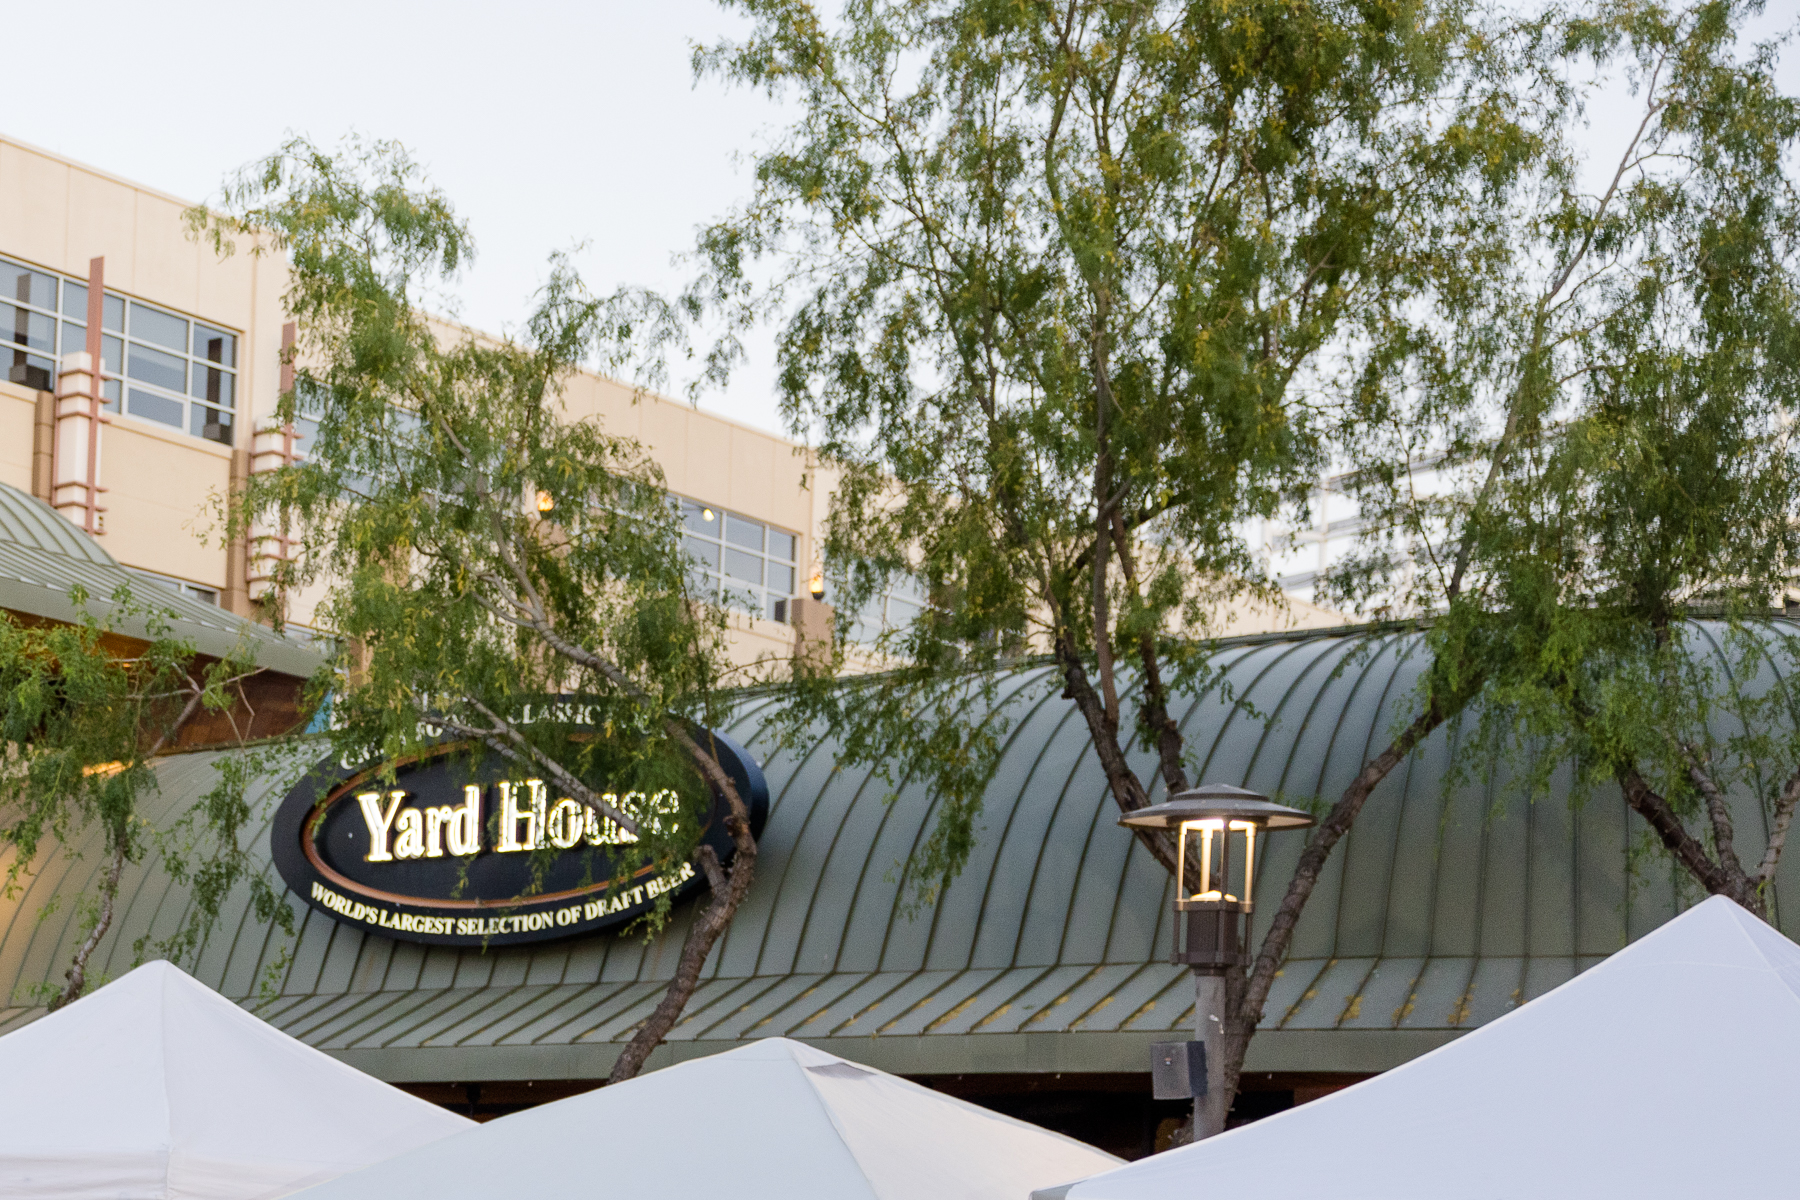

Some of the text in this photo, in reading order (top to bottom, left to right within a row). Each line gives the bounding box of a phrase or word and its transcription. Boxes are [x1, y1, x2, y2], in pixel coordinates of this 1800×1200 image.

[357, 784, 481, 862] Yard
[311, 881, 380, 925] WORLD'S
[378, 908, 456, 935] LARGEST
[456, 911, 555, 936] SELECTION
[555, 905, 583, 927] OF
[584, 885, 644, 921] DRAFT
